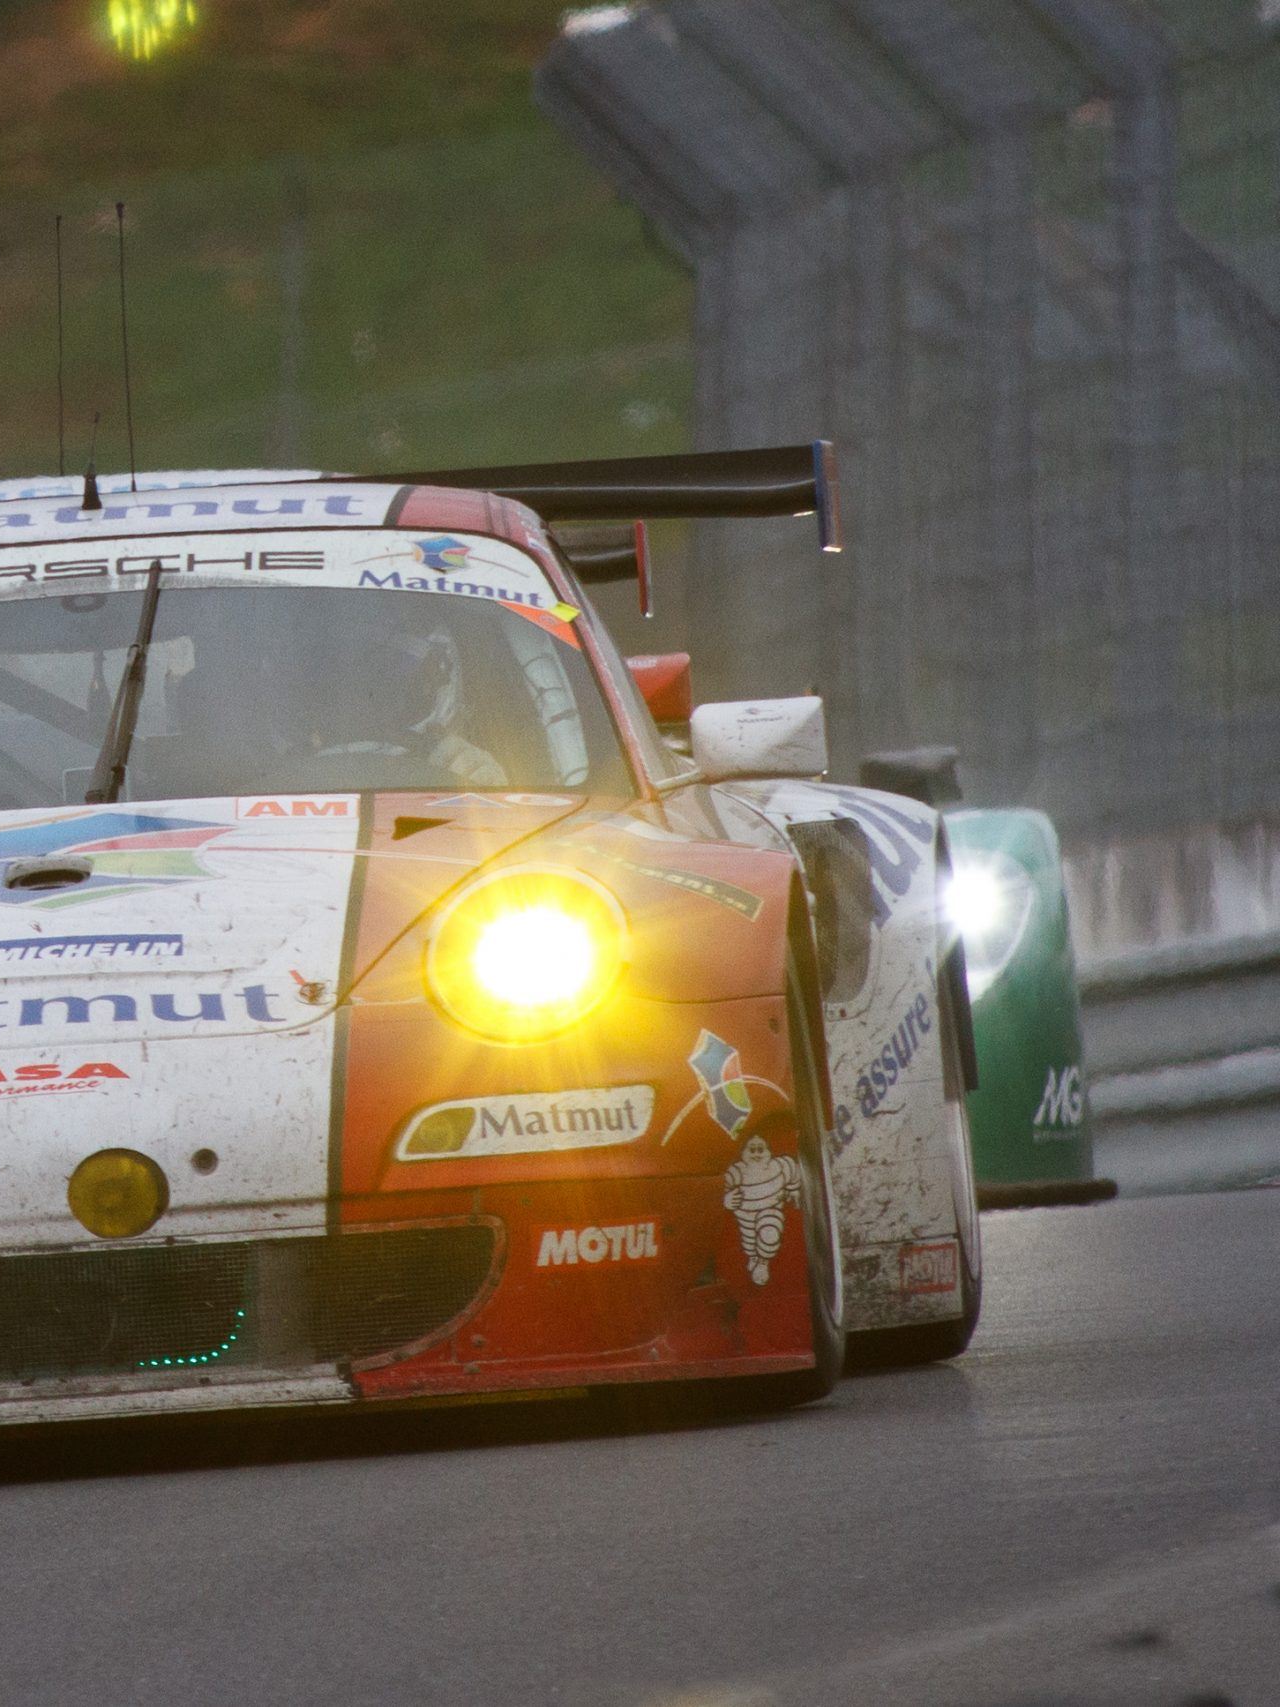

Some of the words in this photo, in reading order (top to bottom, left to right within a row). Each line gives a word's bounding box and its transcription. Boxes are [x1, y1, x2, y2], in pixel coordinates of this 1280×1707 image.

[357, 569, 544, 607] Matmut
[242, 801, 350, 818] AM
[856, 992, 931, 1118] assure
[1033, 1066, 1083, 1126] MG
[477, 1103, 637, 1141] Matmut
[537, 1223, 659, 1268] MOTUL
